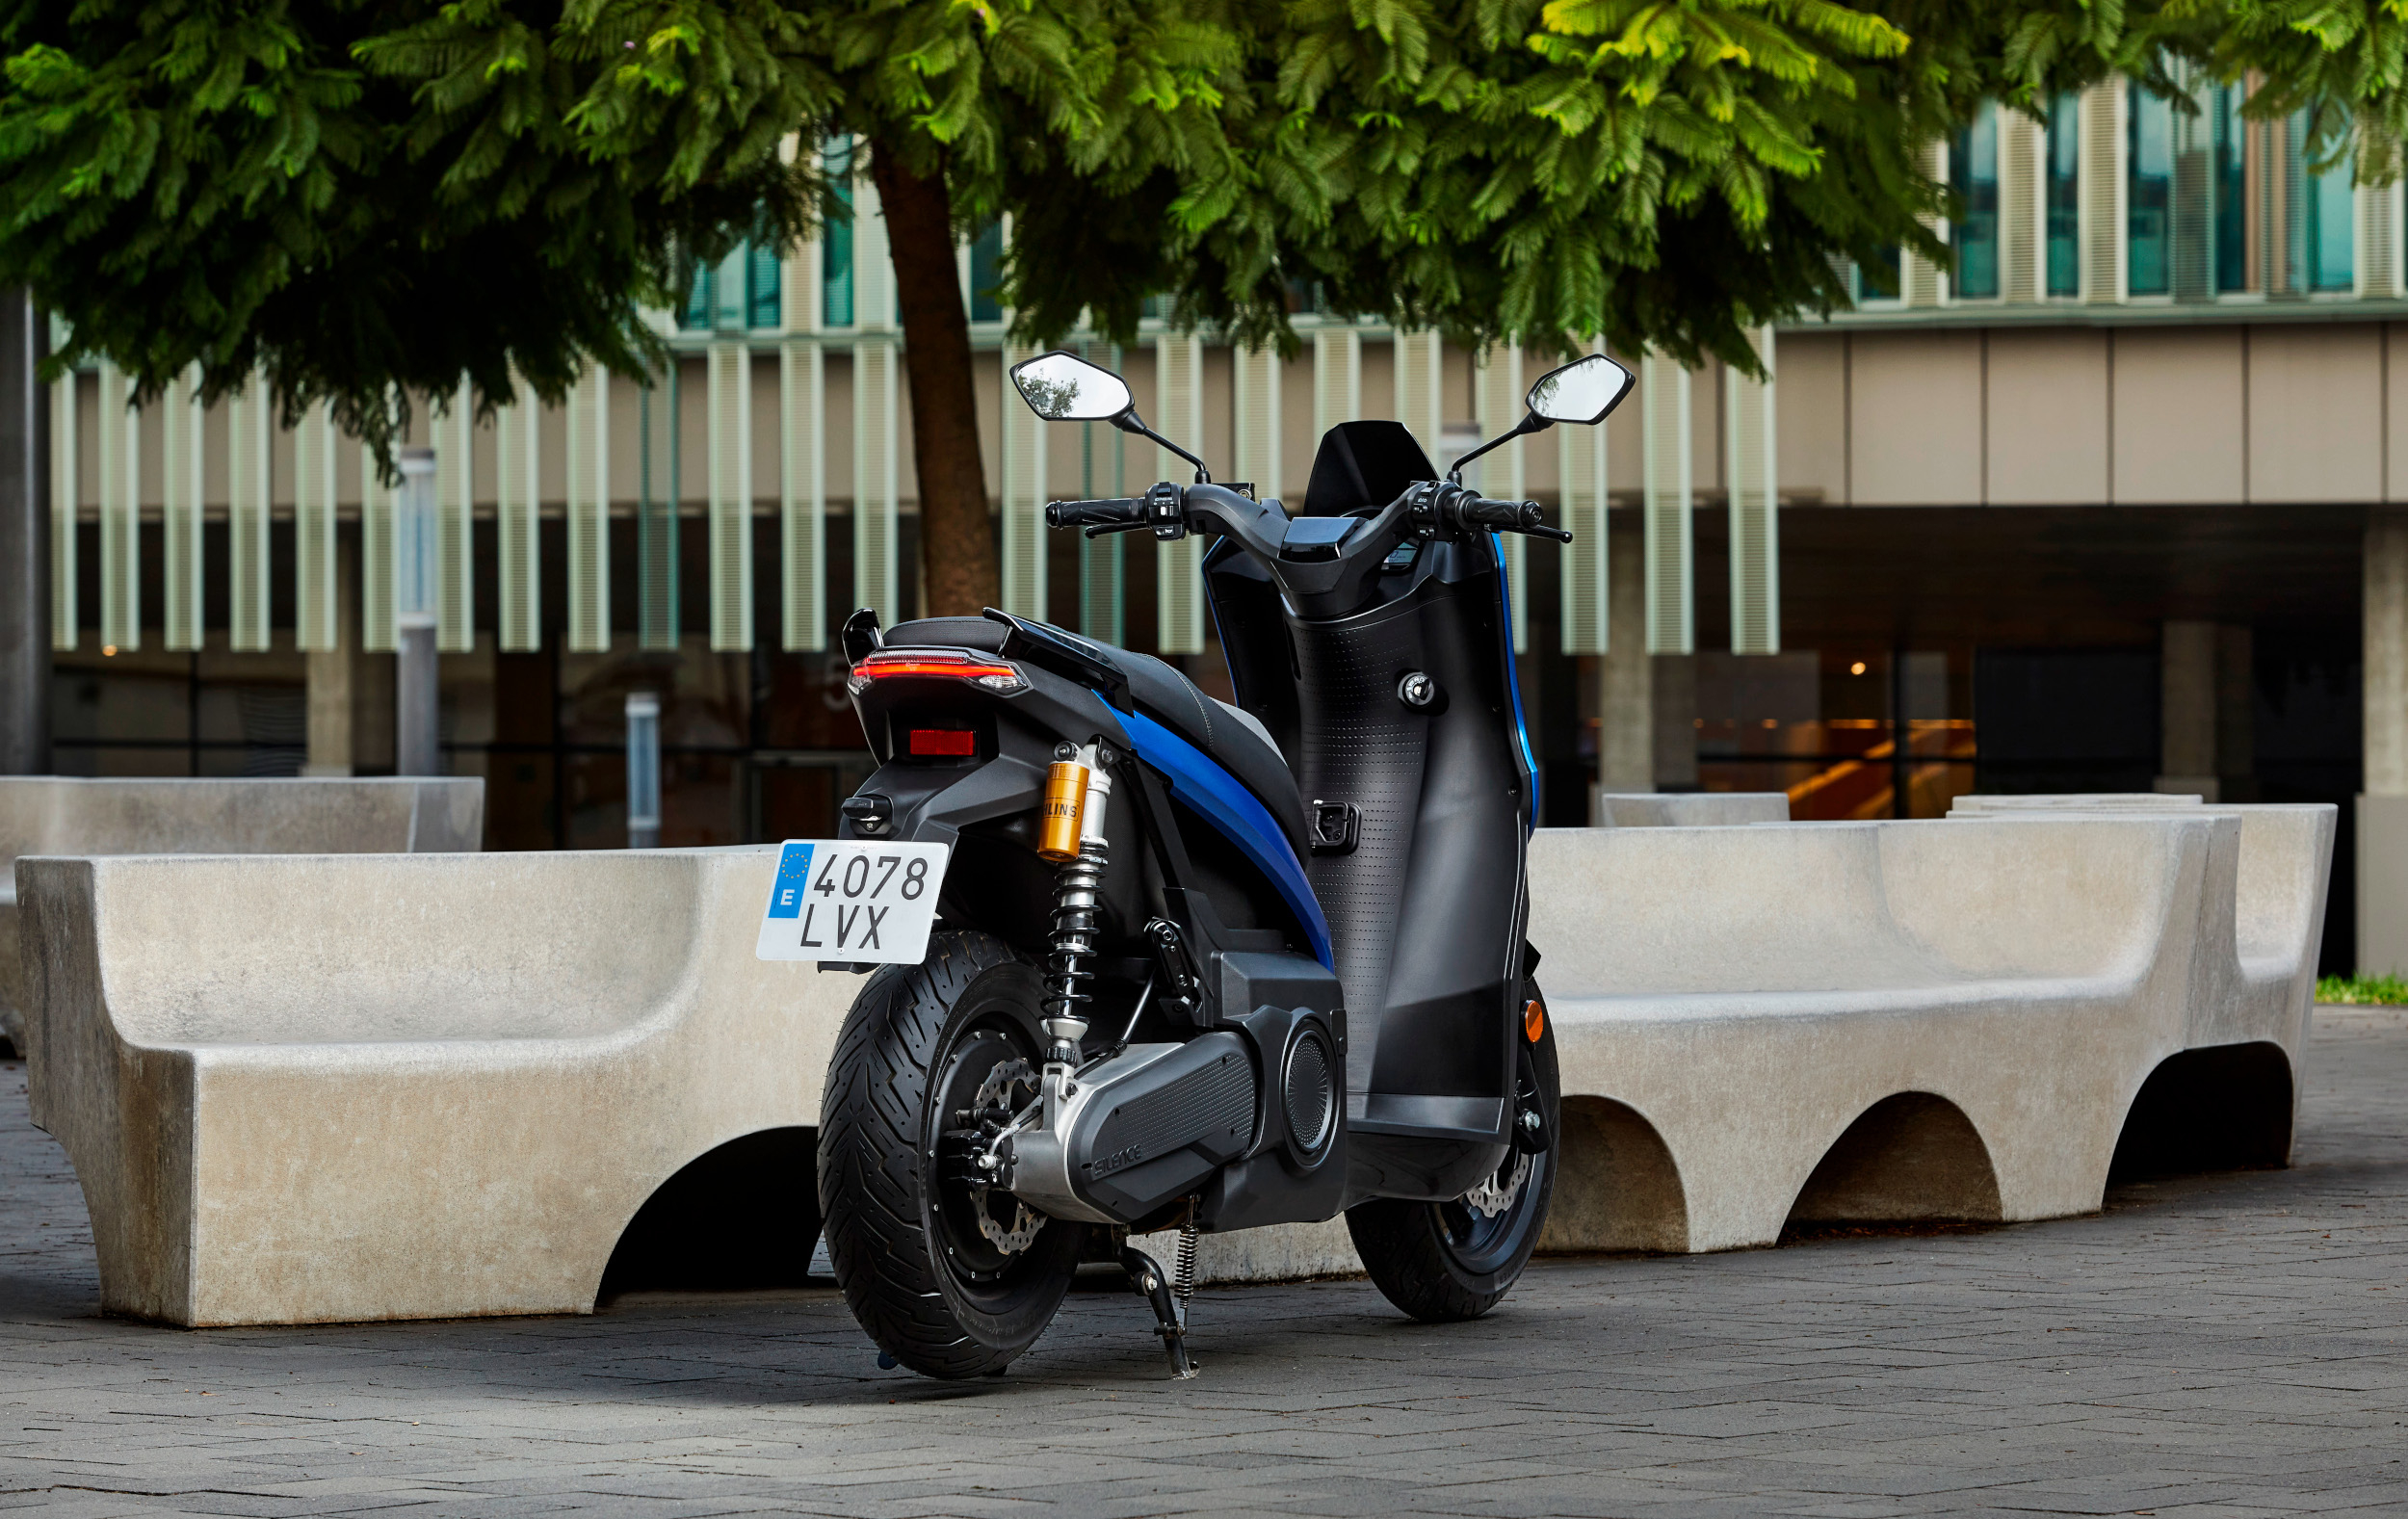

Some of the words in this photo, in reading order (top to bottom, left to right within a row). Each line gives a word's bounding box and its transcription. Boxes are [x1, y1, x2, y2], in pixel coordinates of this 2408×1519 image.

[1043, 802, 1078, 818] HLINS
[813, 853, 929, 901] 4078
[780, 888, 795, 905] E
[799, 903, 890, 950] LVX
[1094, 1144, 1142, 1176] SILENCE
